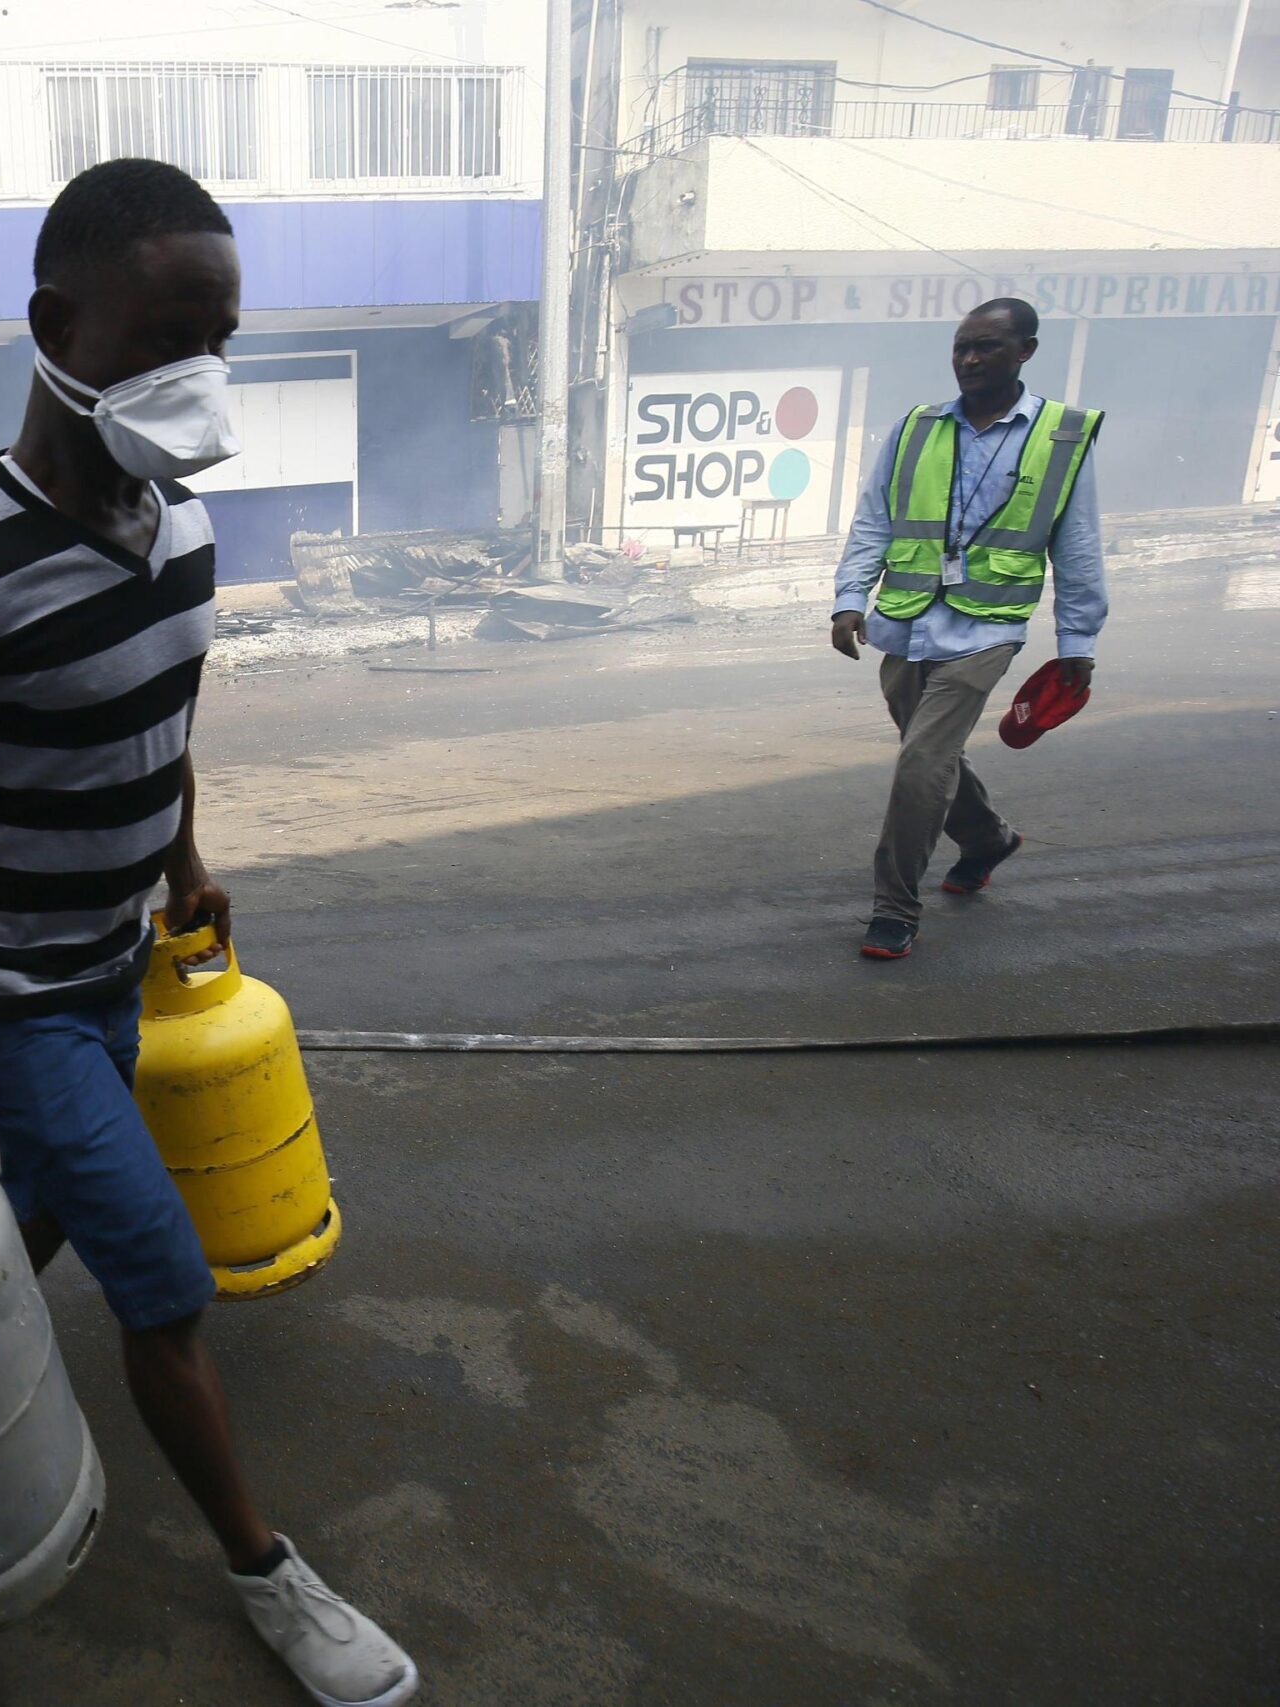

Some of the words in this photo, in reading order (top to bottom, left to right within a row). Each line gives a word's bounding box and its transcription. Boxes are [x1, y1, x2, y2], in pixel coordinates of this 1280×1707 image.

[677, 279, 817, 325] STOP
[844, 284, 862, 310] &
[887, 278, 1019, 319] SHOP
[1035, 275, 1280, 315] SUPERMAR
[634, 450, 765, 501] SHOP
